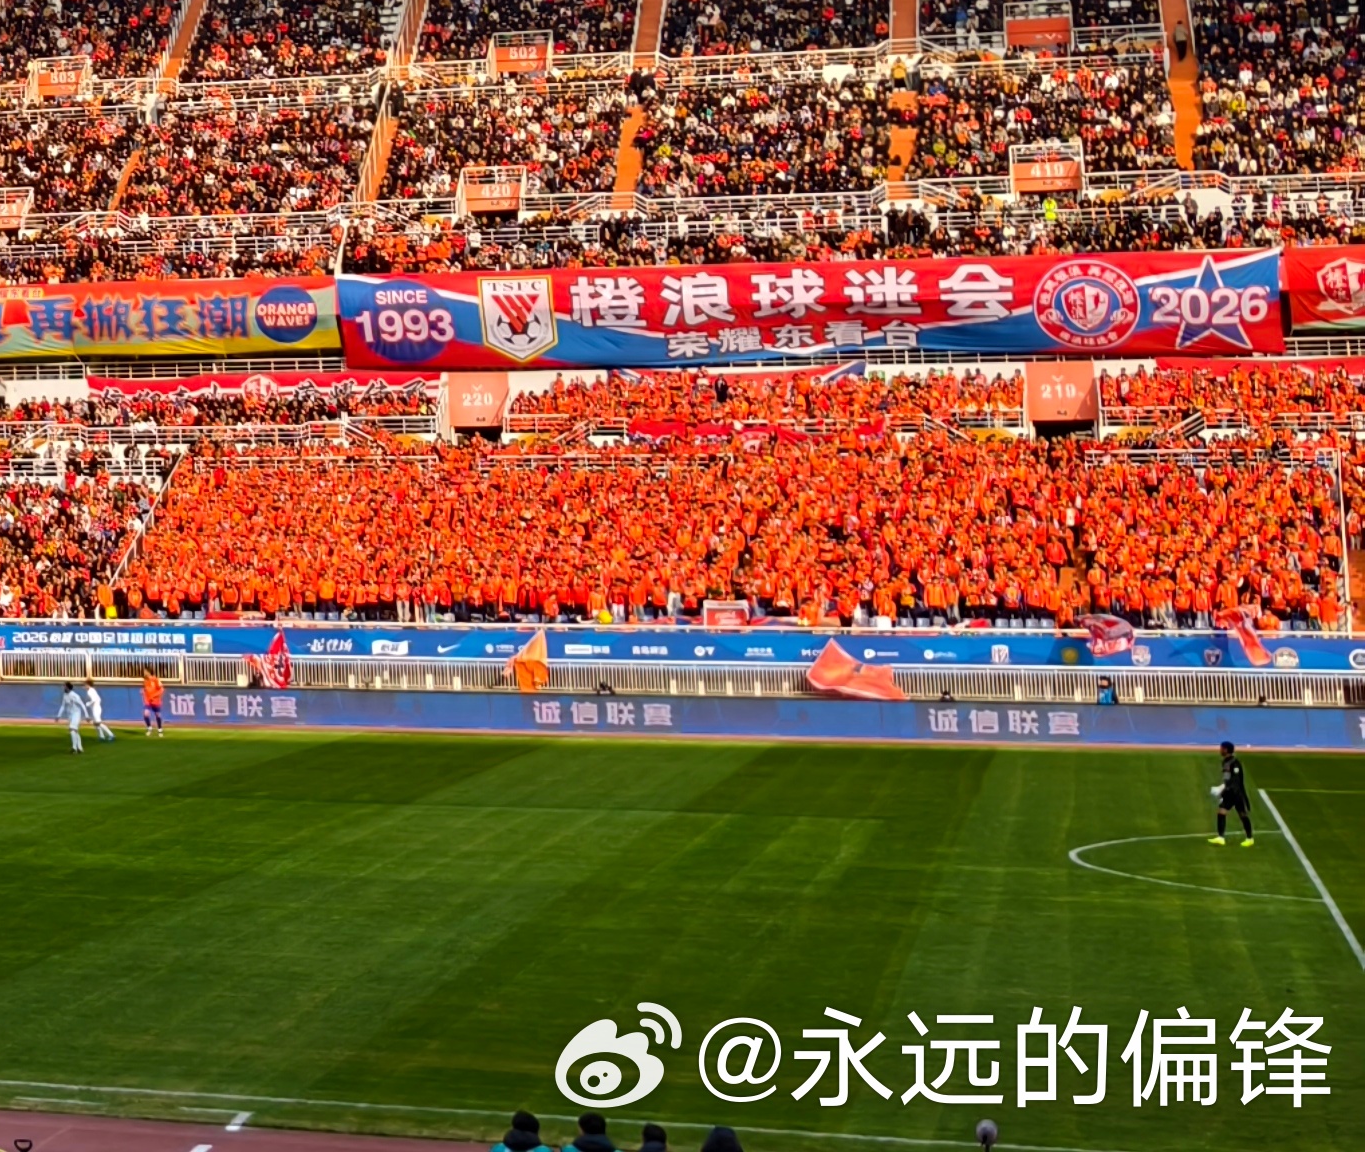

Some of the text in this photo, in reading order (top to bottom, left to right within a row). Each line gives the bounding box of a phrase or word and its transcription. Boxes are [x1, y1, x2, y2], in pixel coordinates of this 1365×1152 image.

[375, 290, 428, 305] SINCE
[487, 281, 542, 292] TSFC
[570, 264, 1014, 328] 橙浪球迷会
[257, 304, 316, 316] ORANGE
[1151, 284, 1269, 325] 2026
[263, 315, 311, 328] WAVES
[356, 309, 455, 345] 1993
[668, 320, 920, 358] 荣耀东看台
[169, 694, 298, 718] 诚信联赛
[532, 700, 673, 726] 诚信联赛
[928, 707, 1080, 735] 诚信联赛
